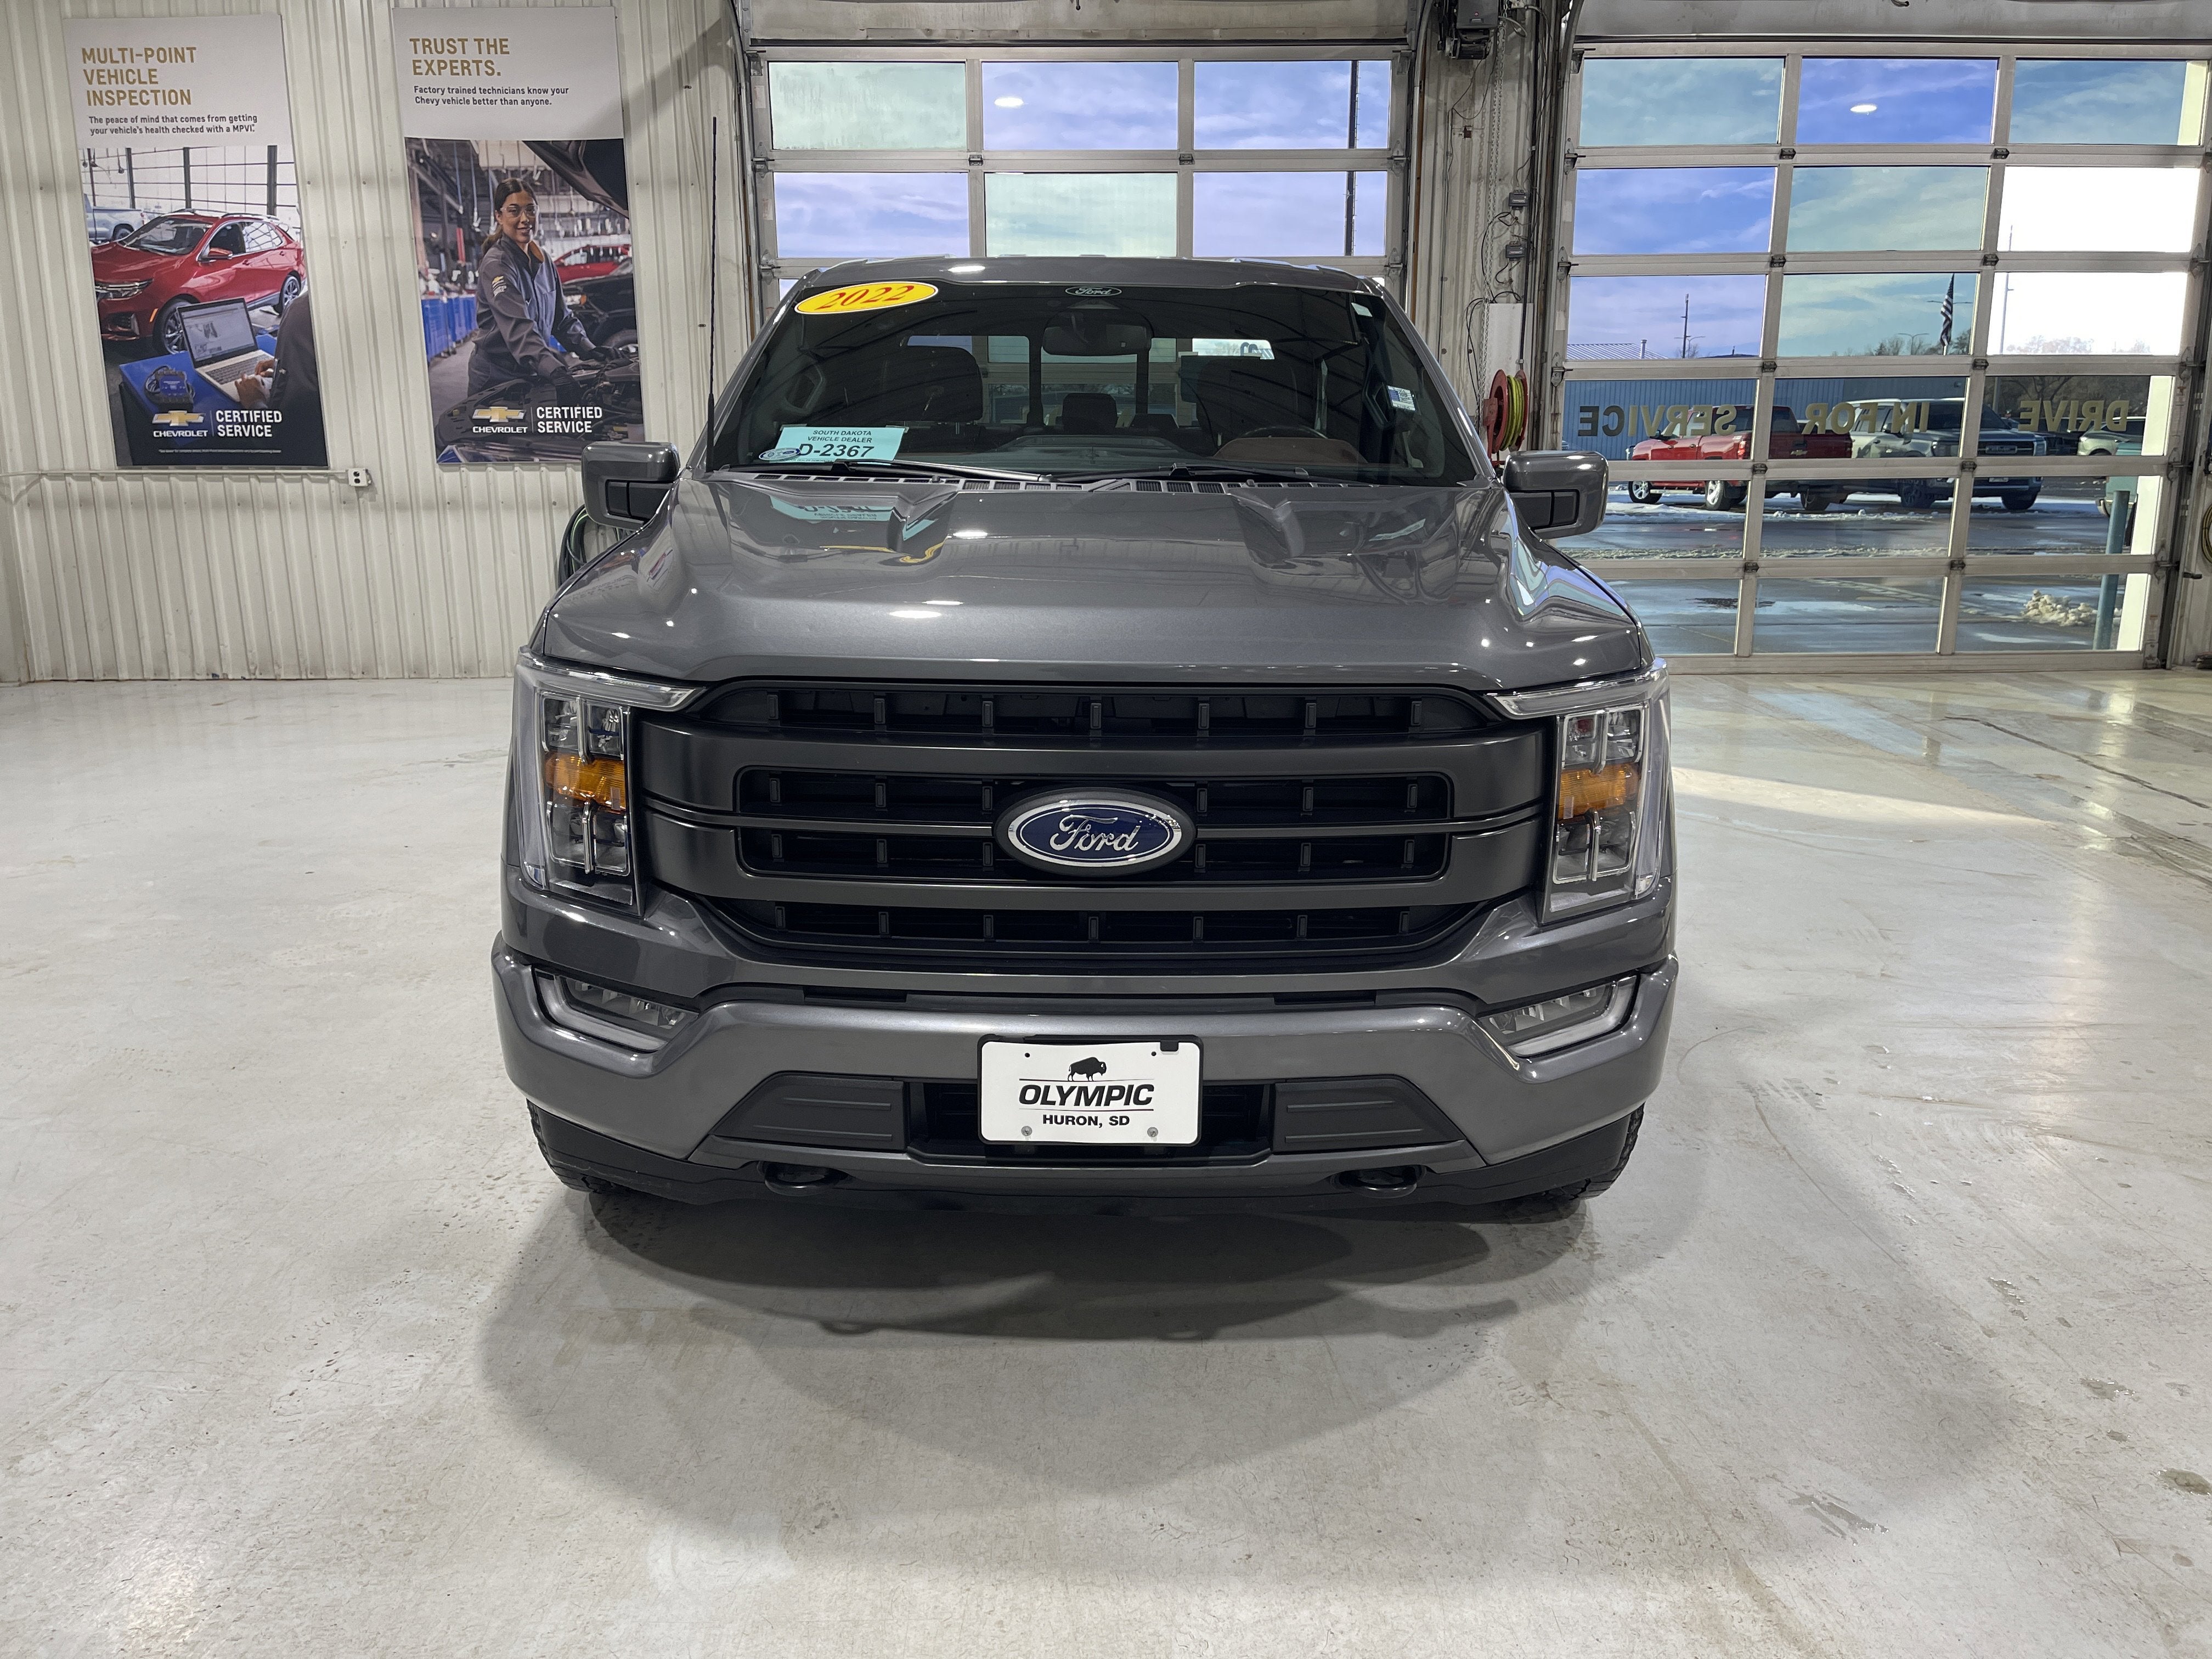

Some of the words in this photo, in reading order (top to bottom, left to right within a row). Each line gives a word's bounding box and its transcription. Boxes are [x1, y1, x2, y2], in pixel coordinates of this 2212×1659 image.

[409, 38, 468, 54] TRUST
[473, 38, 510, 54] THE
[82, 47, 196, 64] MULTI-POINT
[413, 59, 501, 76] EXPERTS.
[83, 69, 158, 84] VEHICLE
[87, 89, 191, 106] INSPECTION
[414, 86, 445, 95] Factory
[479, 86, 525, 94] technicians
[551, 88, 569, 96] your
[415, 96, 439, 106] Chevy
[442, 97, 470, 105] vehicle
[472, 97, 498, 105] better
[521, 99, 552, 107] anyone.
[105, 117, 128, 126] peace
[207, 114, 227, 122] from
[229, 114, 257, 123] getting
[90, 128, 108, 136] your
[814, 285, 915, 311] 2022
[216, 410, 283, 423] CERTIFIED
[537, 407, 602, 419] CERTIFIED
[217, 425, 273, 437] SERVICE
[537, 421, 592, 433] SERVICE
[798, 443, 874, 458] D-2367
[1049, 814, 1141, 851] Ford
[1019, 1084, 1154, 1107] OLYMPIC
[1042, 1114, 1103, 1128] HURON,
[1109, 1115, 1130, 1126] SD
